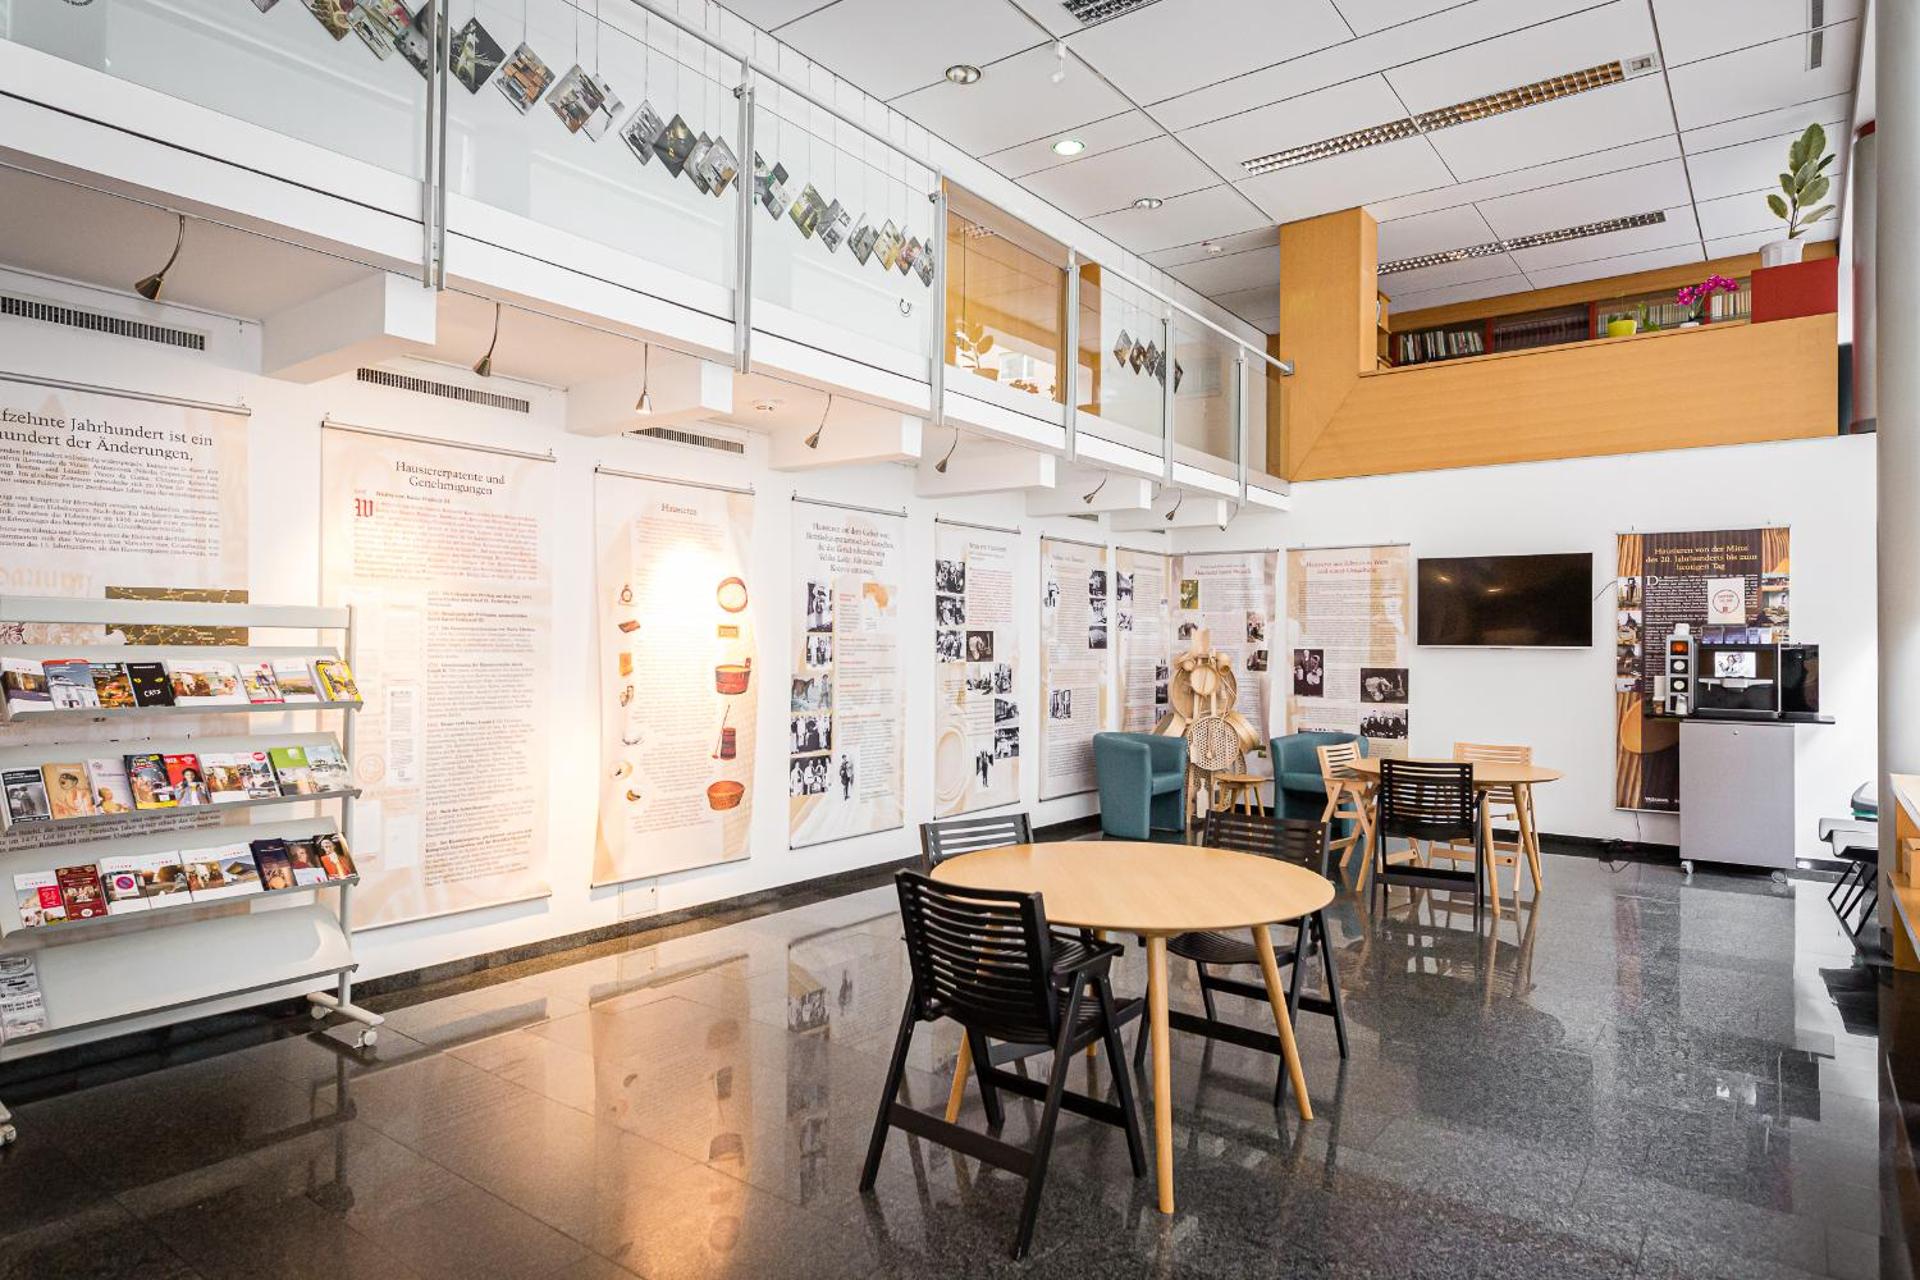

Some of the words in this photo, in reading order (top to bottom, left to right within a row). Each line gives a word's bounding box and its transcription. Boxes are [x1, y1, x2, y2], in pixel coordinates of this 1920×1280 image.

[0, 408, 65, 429] fzehnte
[70, 417, 164, 441] Jahrhundert
[169, 431, 187, 444] ist
[191, 433, 214, 447] ein
[66, 434, 91, 449] der
[97, 436, 194, 462] Änderungen,
[396, 460, 484, 483] Hausiererpatente
[485, 471, 506, 485] und
[408, 475, 493, 496] Genehmigungen
[1712, 562, 1726, 571] Tag
